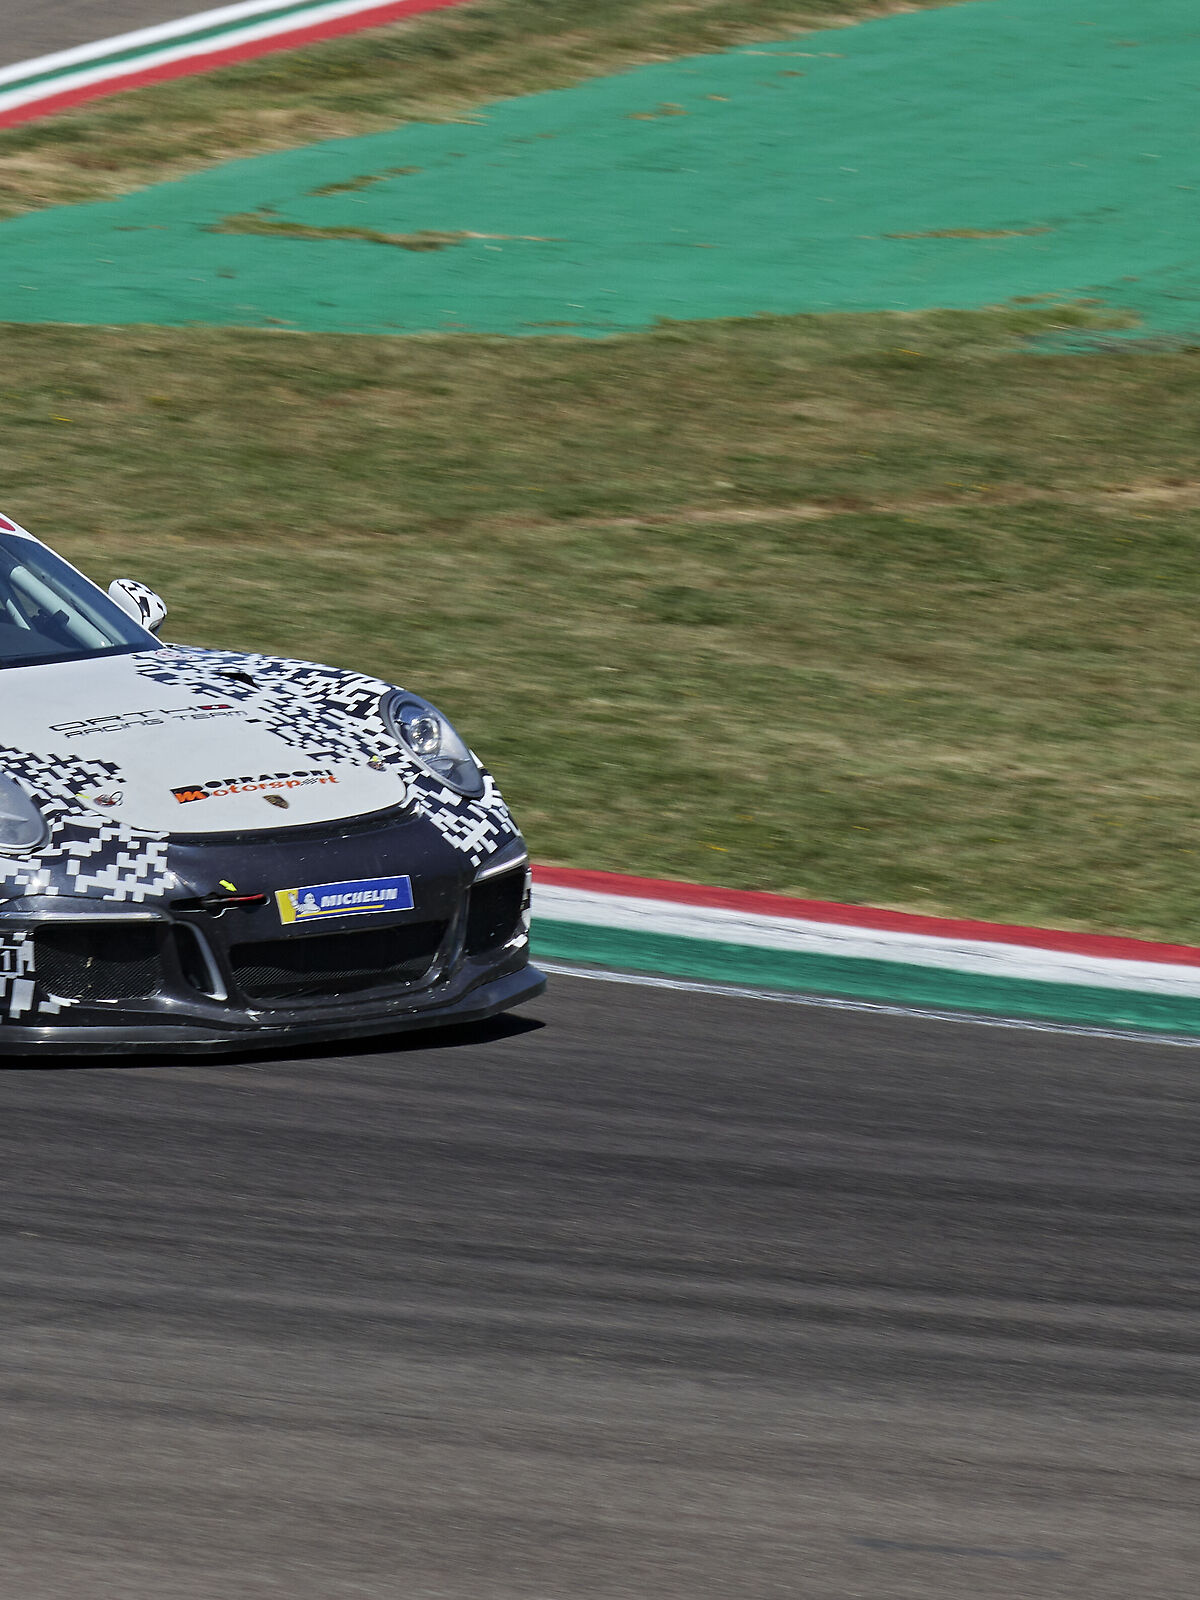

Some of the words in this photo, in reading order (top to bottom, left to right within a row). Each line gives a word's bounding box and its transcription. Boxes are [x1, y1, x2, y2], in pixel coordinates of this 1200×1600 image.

[64, 718, 164, 738] RACING
[172, 710, 249, 721] TEAM
[320, 888, 399, 908] MICHELIN
[0, 950, 11, 971] 1
